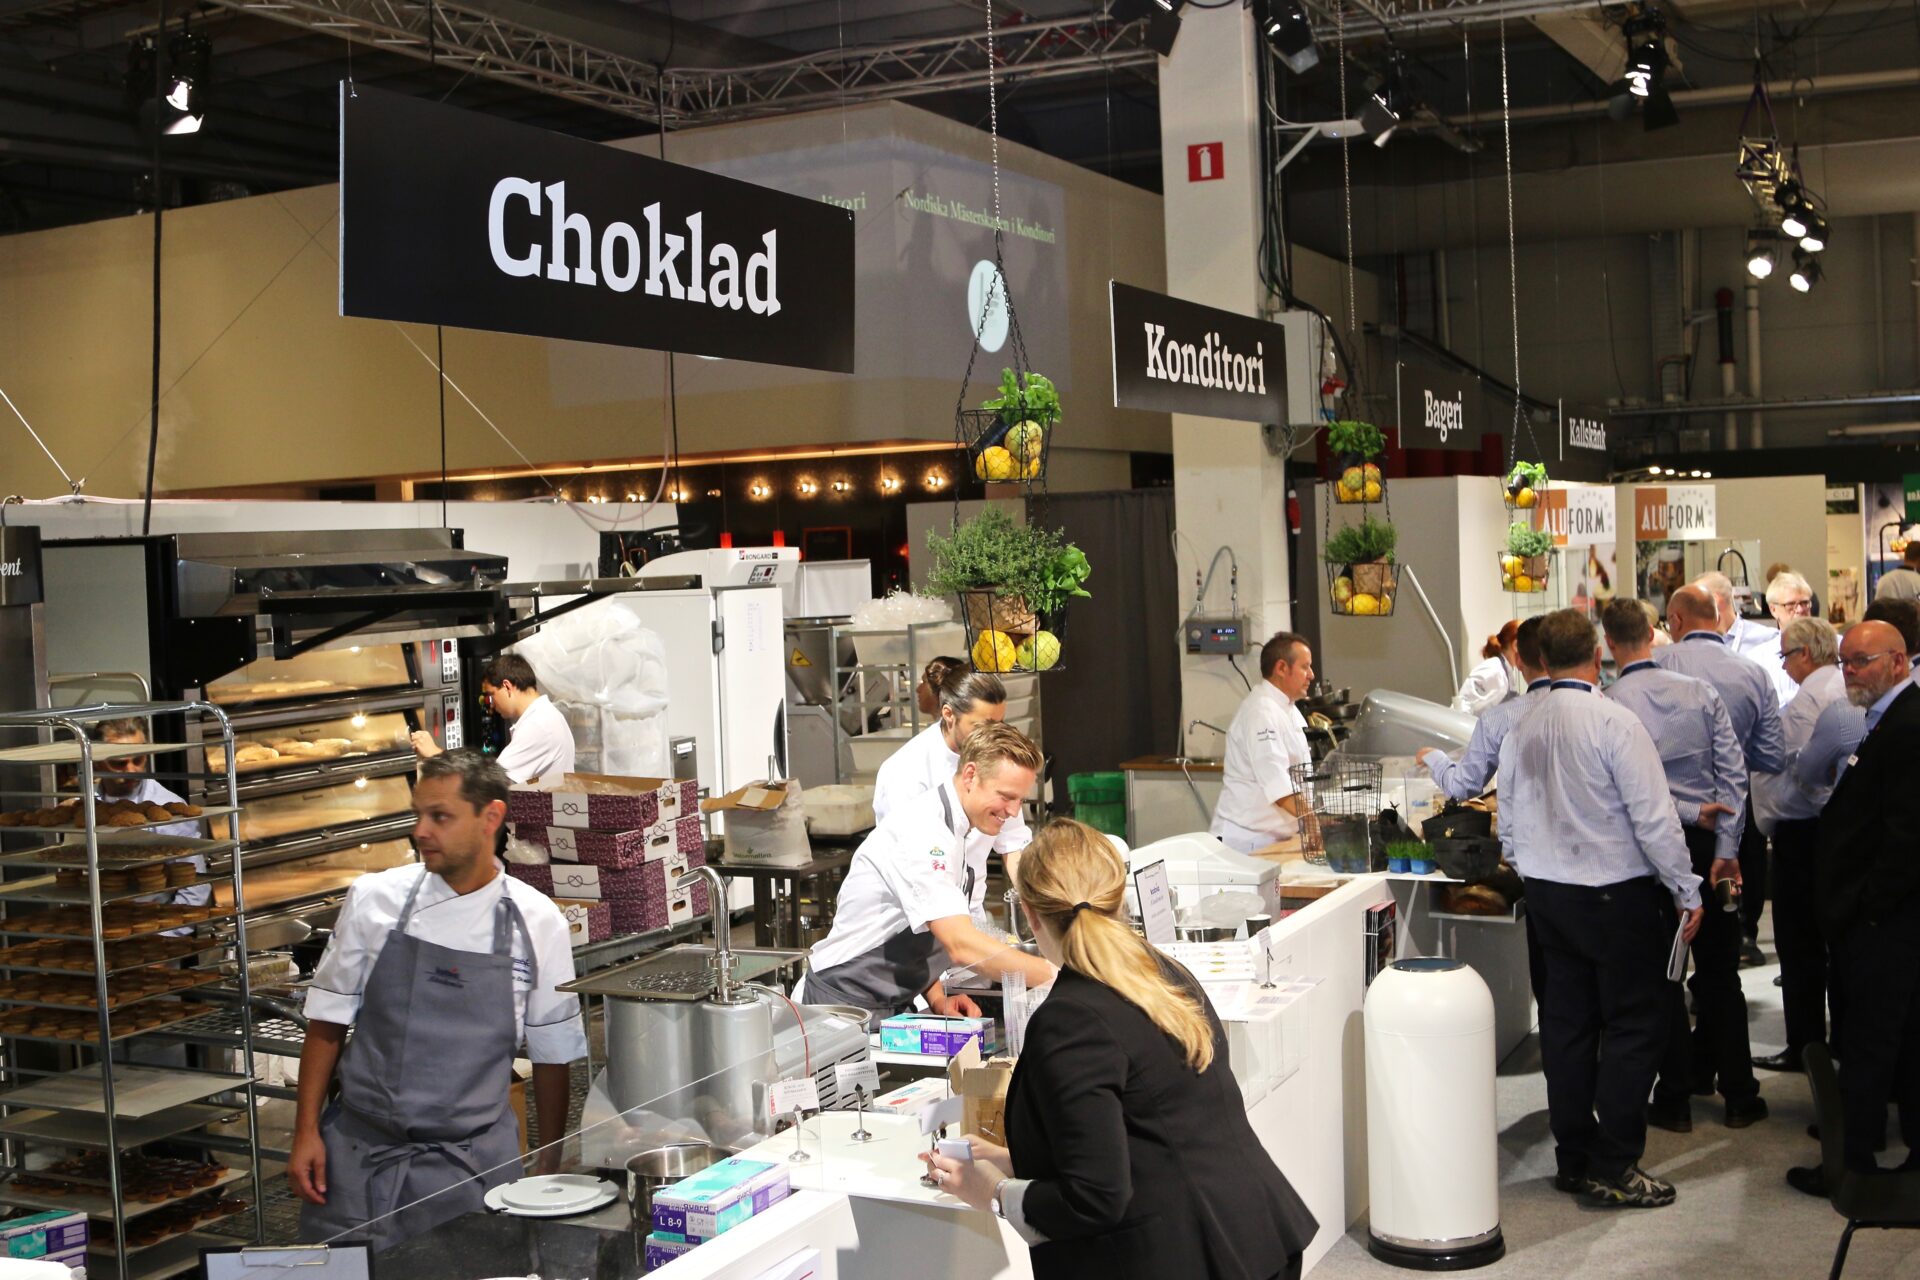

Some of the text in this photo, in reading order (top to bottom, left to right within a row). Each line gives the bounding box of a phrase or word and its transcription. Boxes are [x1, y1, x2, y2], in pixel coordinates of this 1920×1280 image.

[904, 189, 948, 217] Nordiska
[1011, 217, 1015, 233] i
[1017, 217, 1055, 244] Konditori
[488, 176, 781, 317] Choklad
[1144, 322, 1266, 395] Konditori
[1424, 389, 1463, 443] Bageri
[1569, 417, 1606, 451] Kallskänk
[1542, 506, 1605, 537] ALUFORM
[1641, 504, 1705, 532] ALUFORM
[659, 1216, 682, 1228] L 8-9
[653, 1258, 659, 1267] L
